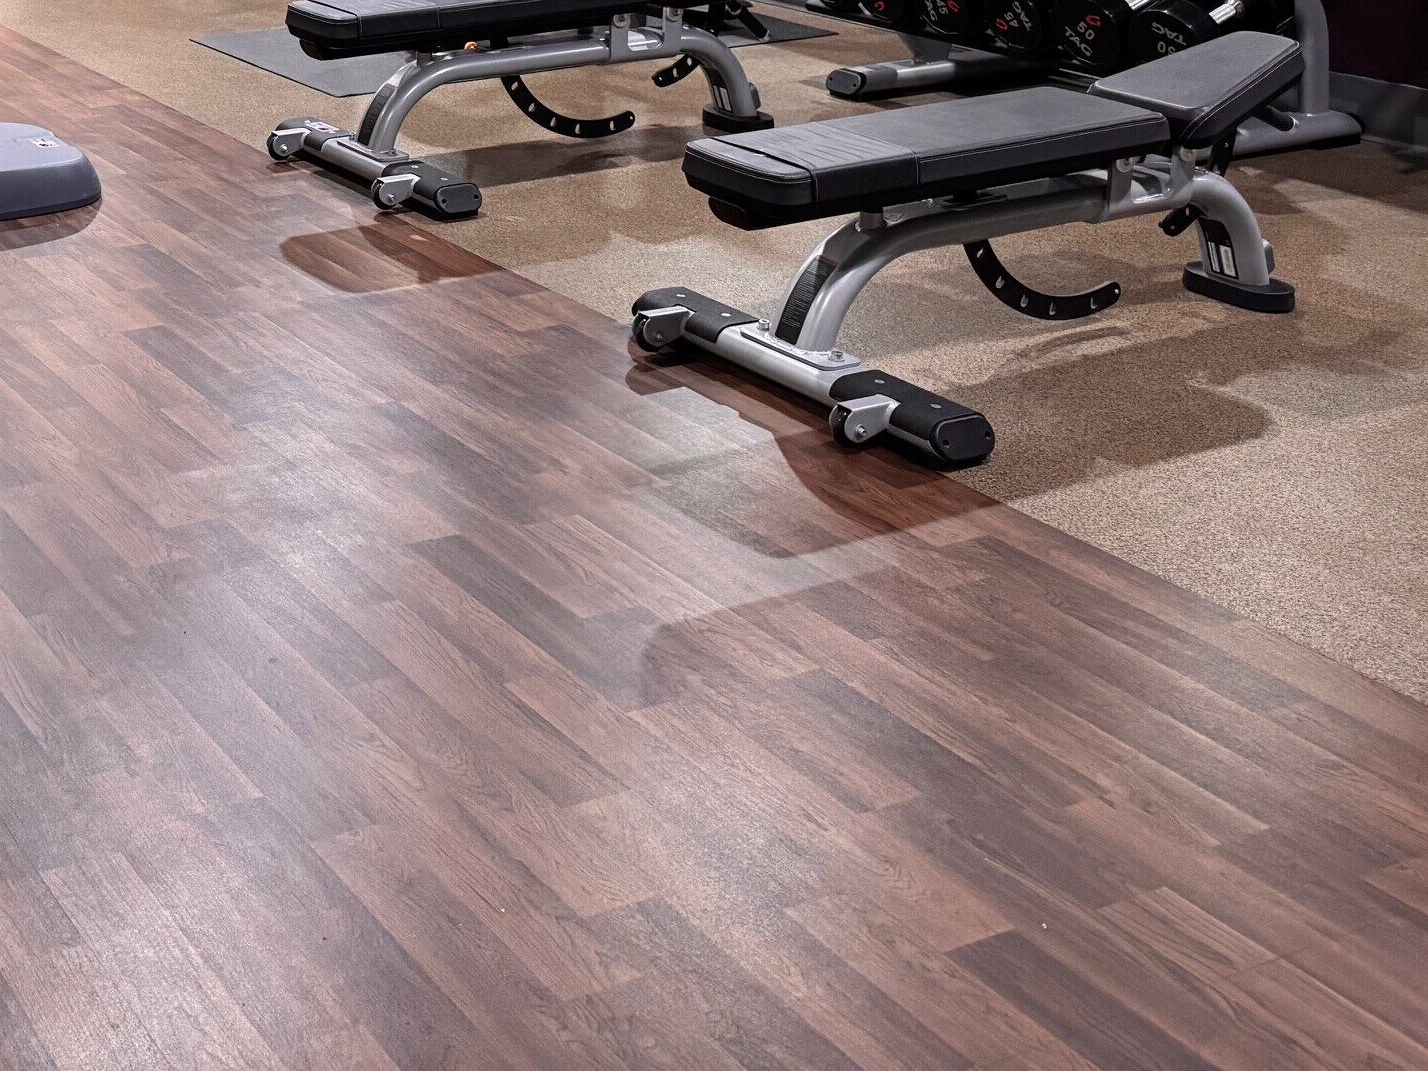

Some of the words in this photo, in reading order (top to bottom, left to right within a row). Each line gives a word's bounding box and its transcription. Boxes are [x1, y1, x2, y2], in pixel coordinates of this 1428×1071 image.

[1004, 12, 1019, 28] 45
[1012, 0, 1033, 31] TAG
[1064, 26, 1093, 57] TAG
[1078, 23, 1095, 40] 50
[1151, 21, 1187, 46] TAG
